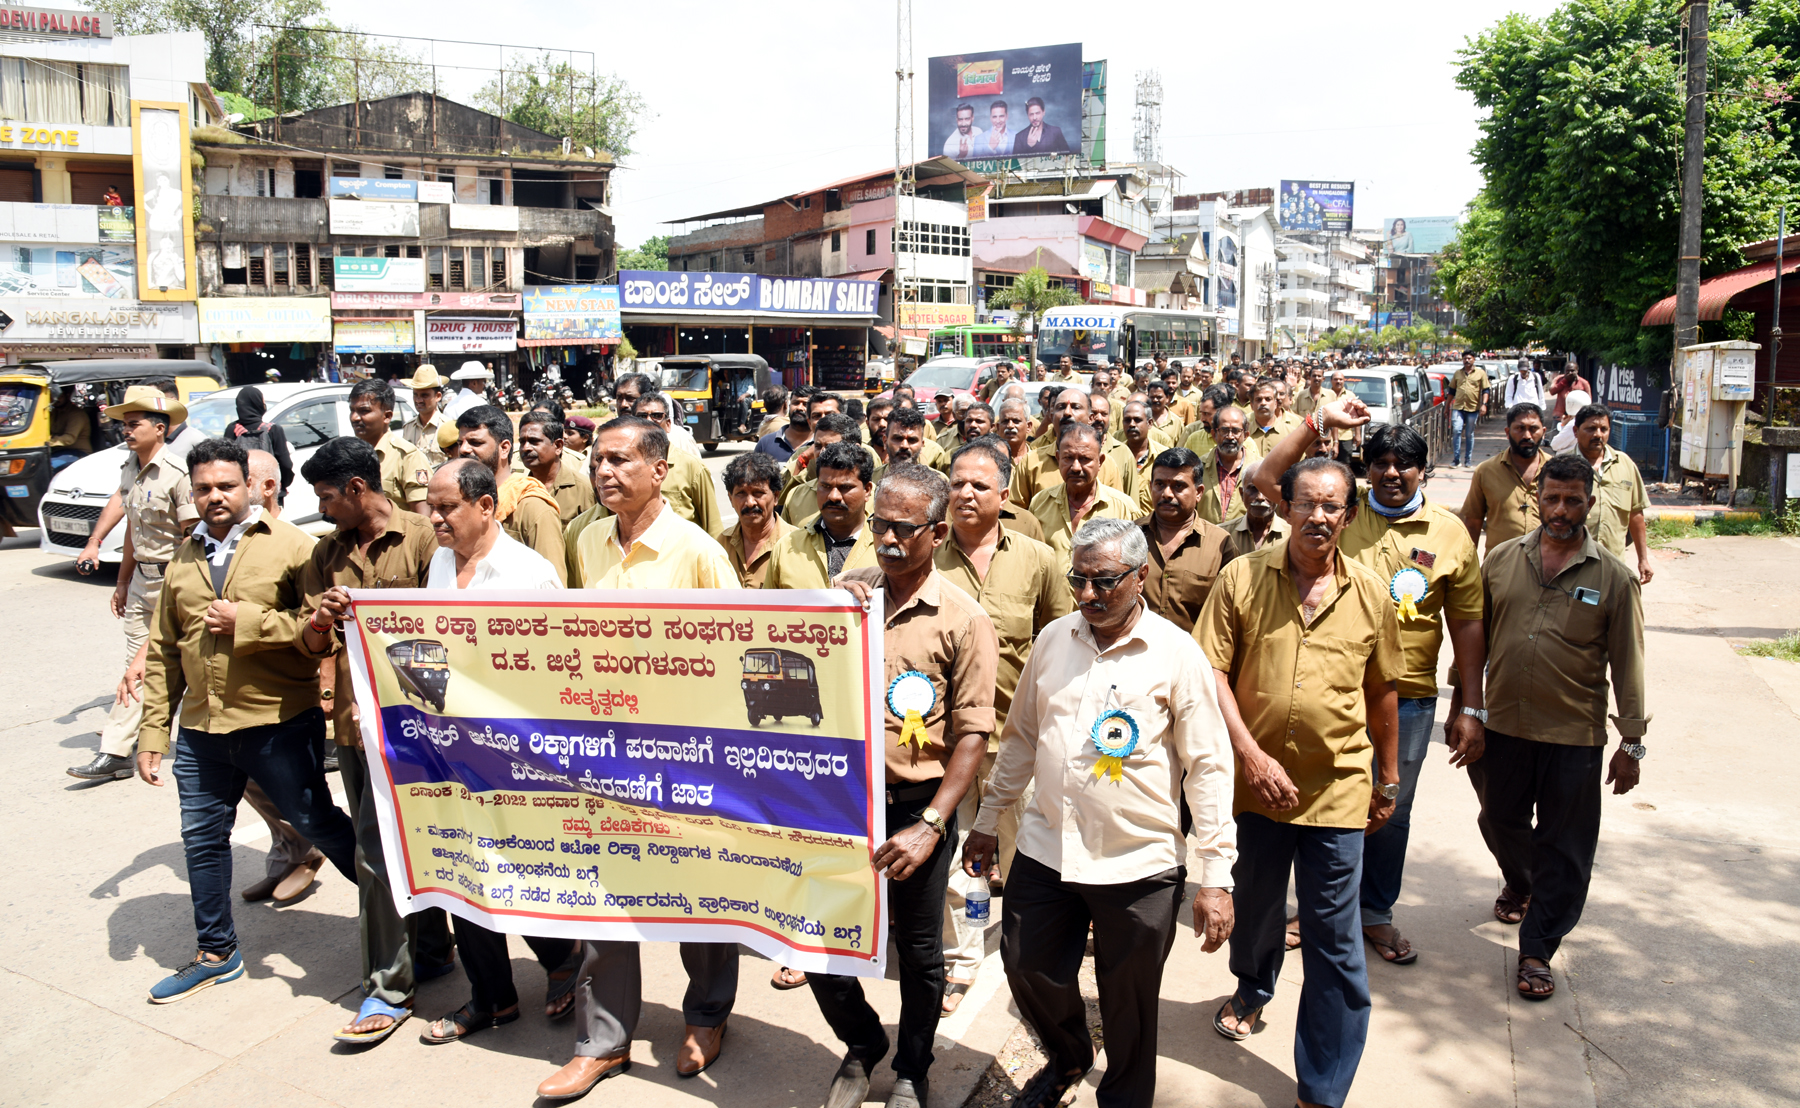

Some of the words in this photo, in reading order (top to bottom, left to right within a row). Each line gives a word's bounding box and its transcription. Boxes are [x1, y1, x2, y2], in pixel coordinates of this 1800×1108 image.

[0, 9, 37, 31] DEVI
[40, 13, 101, 34] PALACE
[20, 127, 79, 147] ZONE
[864, 187, 885, 200] SAGAR
[1332, 200, 1351, 208] CFAL
[336, 294, 371, 304] DRUG
[373, 294, 414, 304] HOUSE
[624, 273, 689, 305] ಬಾಂಬೆ
[693, 273, 751, 306] ಸೇಲ್
[760, 278, 834, 311] BOMBAY
[836, 282, 876, 312] SALE
[545, 299, 578, 312] NEW
[580, 299, 616, 312] STAR
[26, 311, 158, 326] MANGALADEVI
[429, 322, 467, 333] DRUG
[471, 322, 514, 333] HOUSE
[908, 314, 936, 324] HOTEL
[938, 314, 967, 324] SAGAR
[1046, 317, 1116, 328] MAROLI
[48, 327, 128, 336] JEWELLERS
[95, 346, 152, 354] JEWELLERS
[366, 611, 424, 634] ಆಟೋ
[435, 615, 478, 646] ರಿಕ್ಷಾ
[664, 615, 754, 645] ಸಂಘಗಳ
[767, 618, 848, 657] ಒಕ್ಕೂಟ
[491, 647, 536, 671] ದ.ಕ.
[546, 648, 583, 681] ಜಿಲ್ಲೆ
[593, 649, 715, 678] ಮಂಗಳೂರು
[559, 687, 640, 717] ನೇತೃತ್ವದಲ್ಲಿ
[529, 729, 616, 769] ರಿಕ್ಷಾಗಳಿಗೆ
[626, 735, 714, 764] ಪರವಾಣಿಗೆ
[724, 745, 848, 781] ಇಲ್ಲದಿರುವುದರ
[578, 769, 663, 802] ಮೆರವಣಿಗೆ
[671, 783, 714, 807] ಜಾತ
[410, 785, 453, 798] ದಿನಾಂಕ
[532, 795, 580, 809] ಬುಧವಾರ
[585, 797, 605, 816] ಸ್ಥಳ
[562, 816, 593, 839] ನಮ್ಮ
[600, 816, 671, 835] ಬೇಡಿಕೆಗಳು
[561, 838, 600, 855] ಆಟೋ
[608, 841, 641, 862] ರಿಕ್ಷಾ
[647, 842, 711, 864] ನಿಲ್ದಾಣಗಳ
[497, 862, 570, 881] ಉಲ್ಲಂಘನೆಯ
[577, 865, 599, 888] ಬಗ್ಗೆ
[436, 867, 454, 882] ದರ
[491, 885, 514, 907] ಬಗ್ಗೆ
[520, 886, 551, 904] ನಡೆದ
[556, 889, 597, 908] ಸಭೆಯ
[604, 892, 693, 915] ನಿರ್ಧಾರವನ್ನು
[698, 896, 759, 914] ಪ್ರಾಧಿಕಾರ
[764, 905, 825, 937] ಉಲ್ಲಂಘನೆಯ
[834, 925, 862, 949] ಬಗ್ಗೆ
